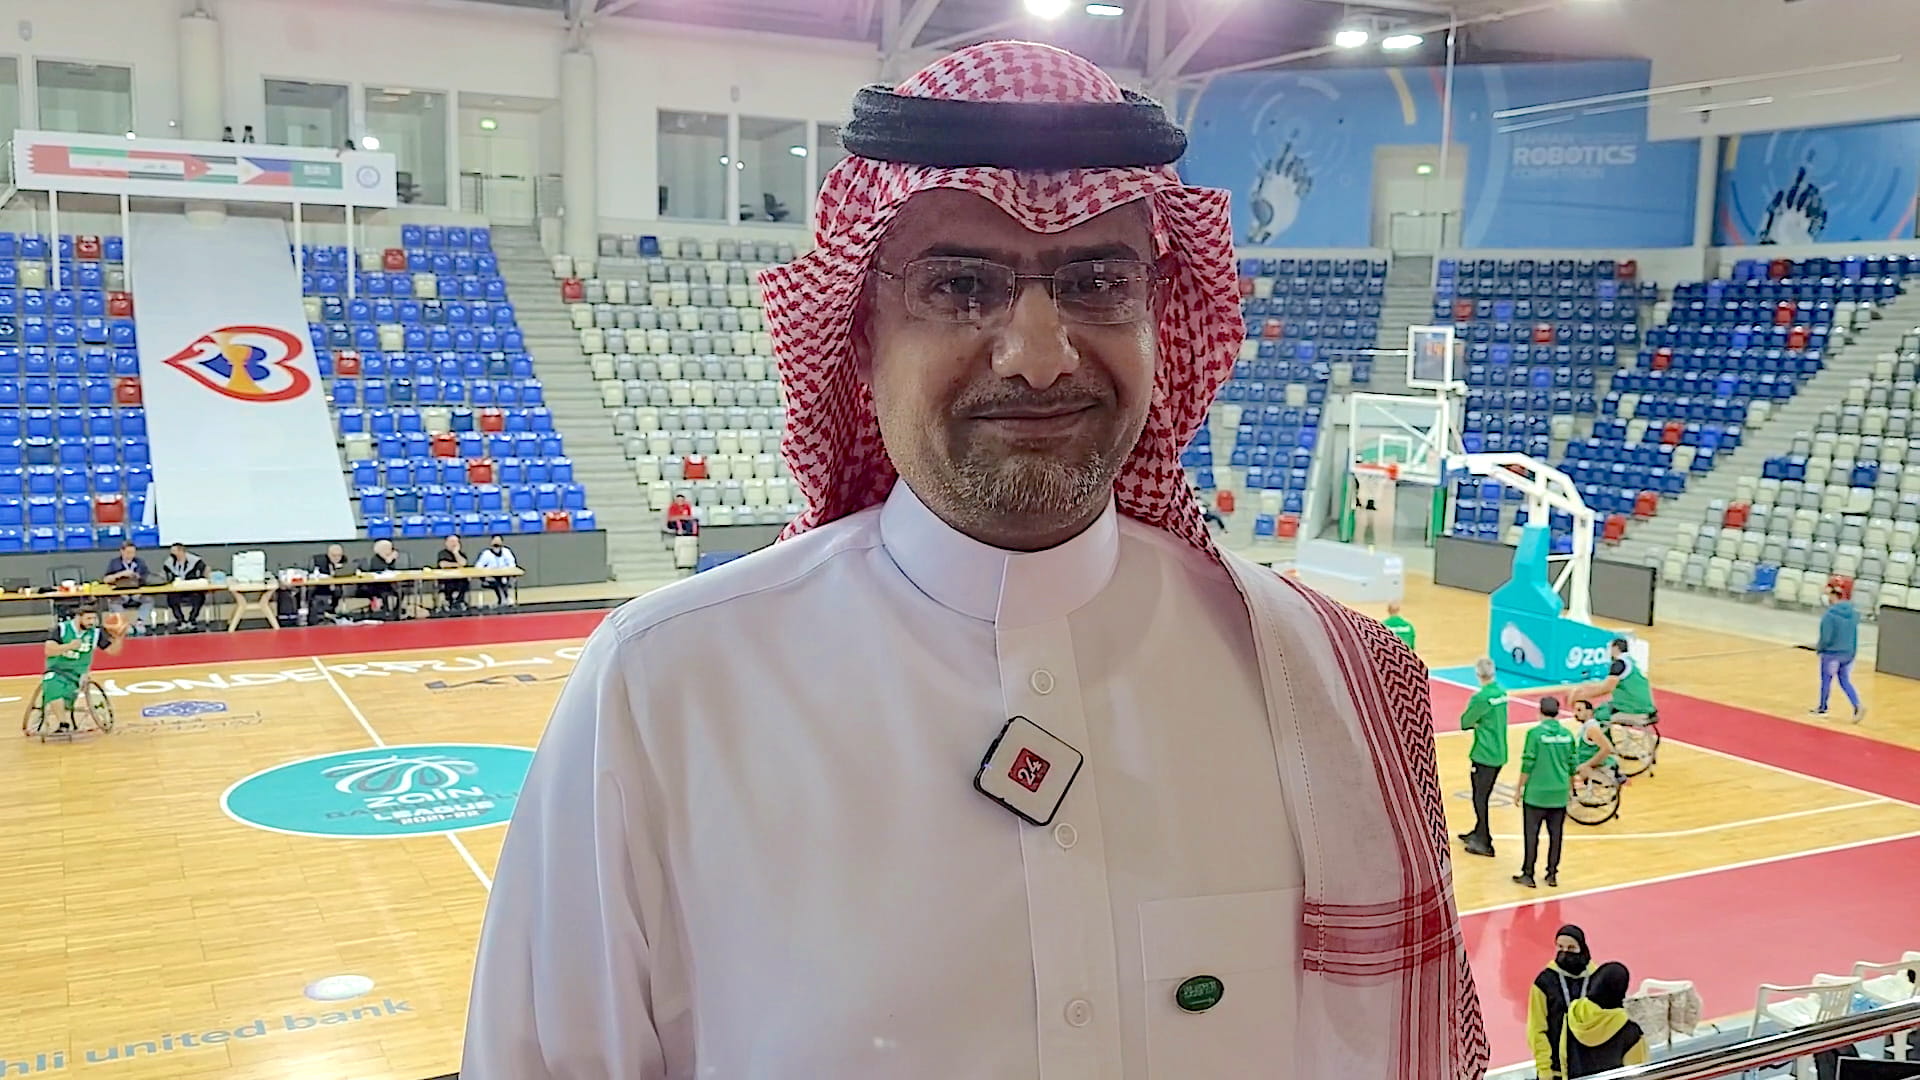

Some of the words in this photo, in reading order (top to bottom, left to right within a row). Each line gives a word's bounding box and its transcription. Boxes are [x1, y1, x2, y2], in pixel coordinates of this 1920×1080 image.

[1513, 146, 1637, 166] ROBOTICS
[1017, 756, 1042, 785] 24
[363, 786, 485, 809] zain
[373, 800, 496, 821] LEAGUE
[86, 1020, 267, 1063] united
[283, 998, 417, 1031] bank
